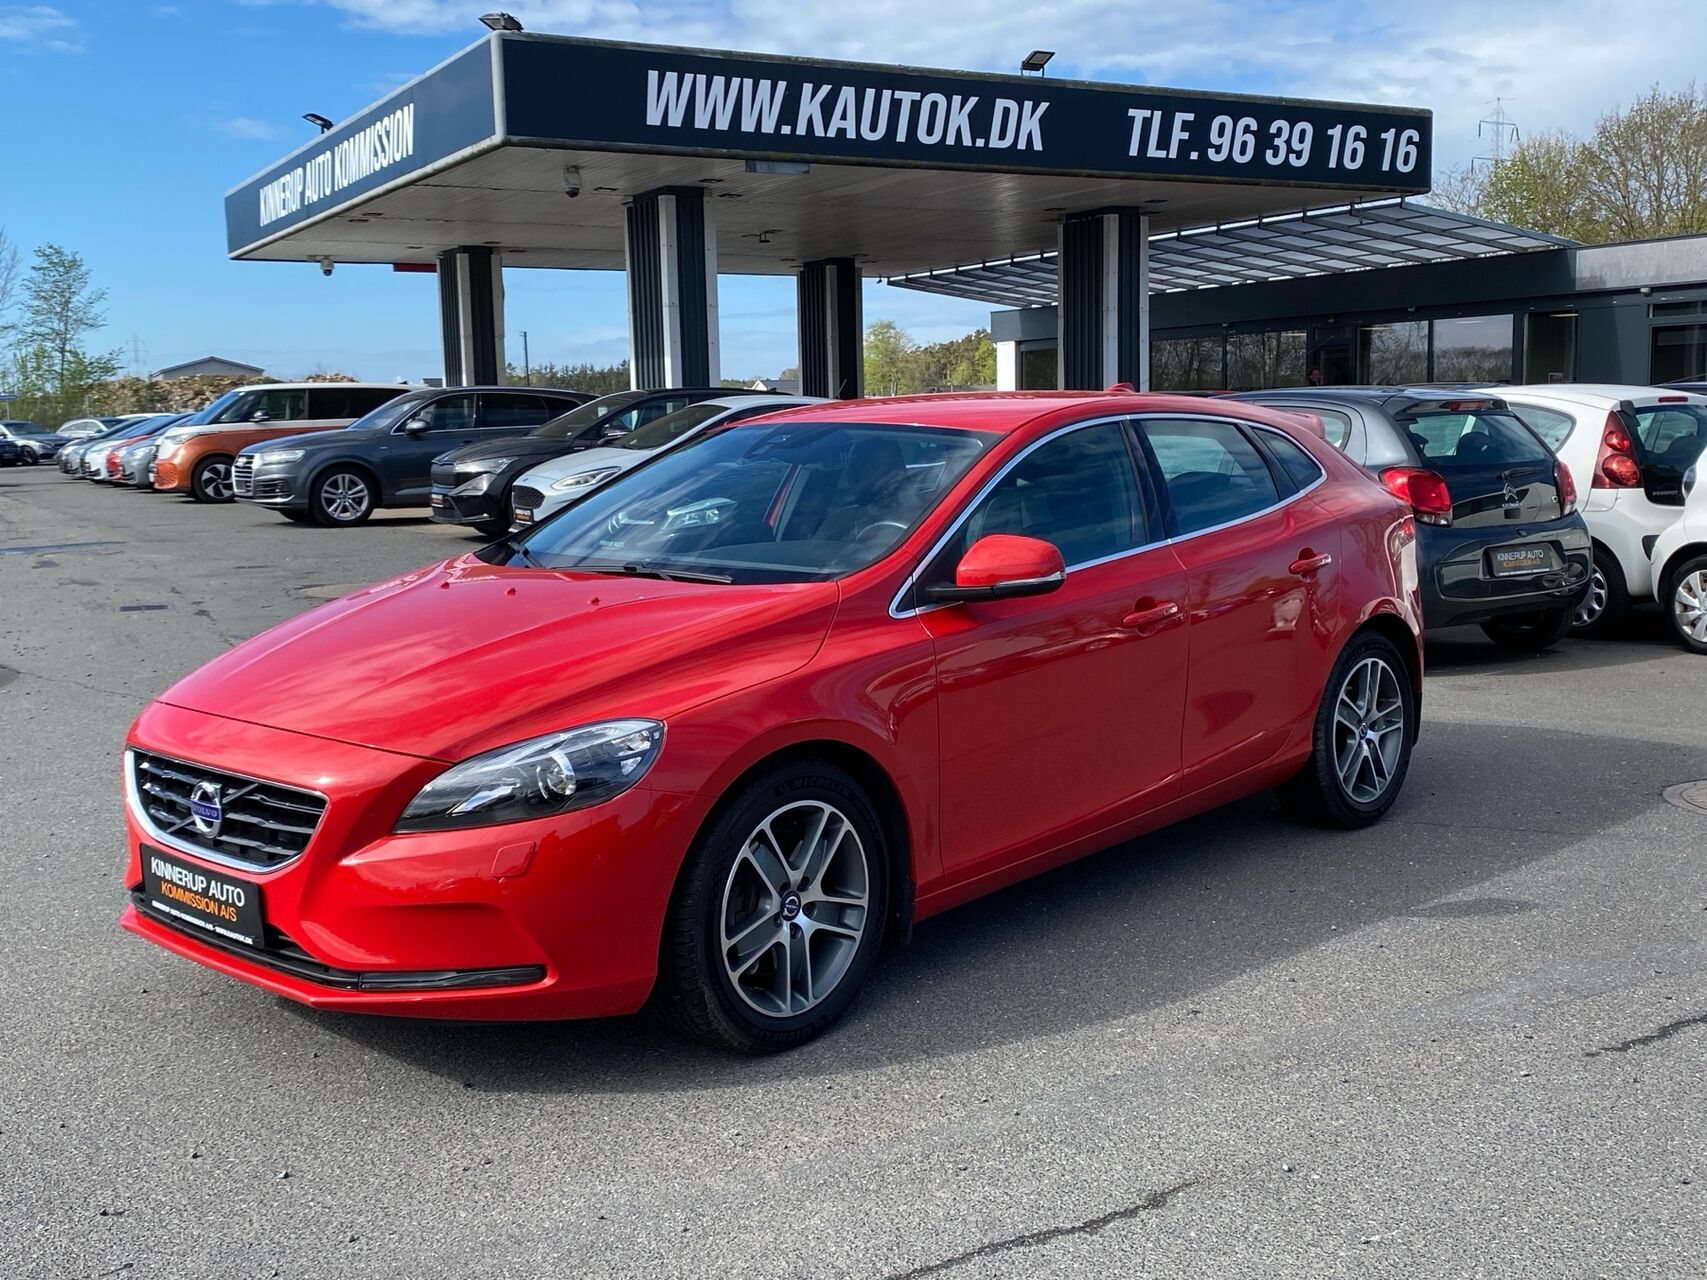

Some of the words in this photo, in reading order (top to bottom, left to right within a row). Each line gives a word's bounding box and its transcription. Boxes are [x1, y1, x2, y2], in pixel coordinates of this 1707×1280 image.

[646, 69, 1050, 151] WWW.KAUTOK.DK
[259, 166, 304, 227] KINNERUP
[304, 150, 332, 206] AUTO
[334, 102, 415, 192] KOMMISSION
[1127, 108, 1199, 161] TLF.
[1207, 114, 1259, 164] 96
[1265, 118, 1314, 168] 39
[1327, 124, 1368, 170] 16
[1380, 128, 1420, 173] 16
[1497, 551, 1527, 561] KINNERUP
[1527, 549, 1544, 559] AUTO
[151, 856, 207, 893] KINNERUP
[208, 880, 245, 907] AUTO
[161, 881, 218, 916] KOMMISSION
